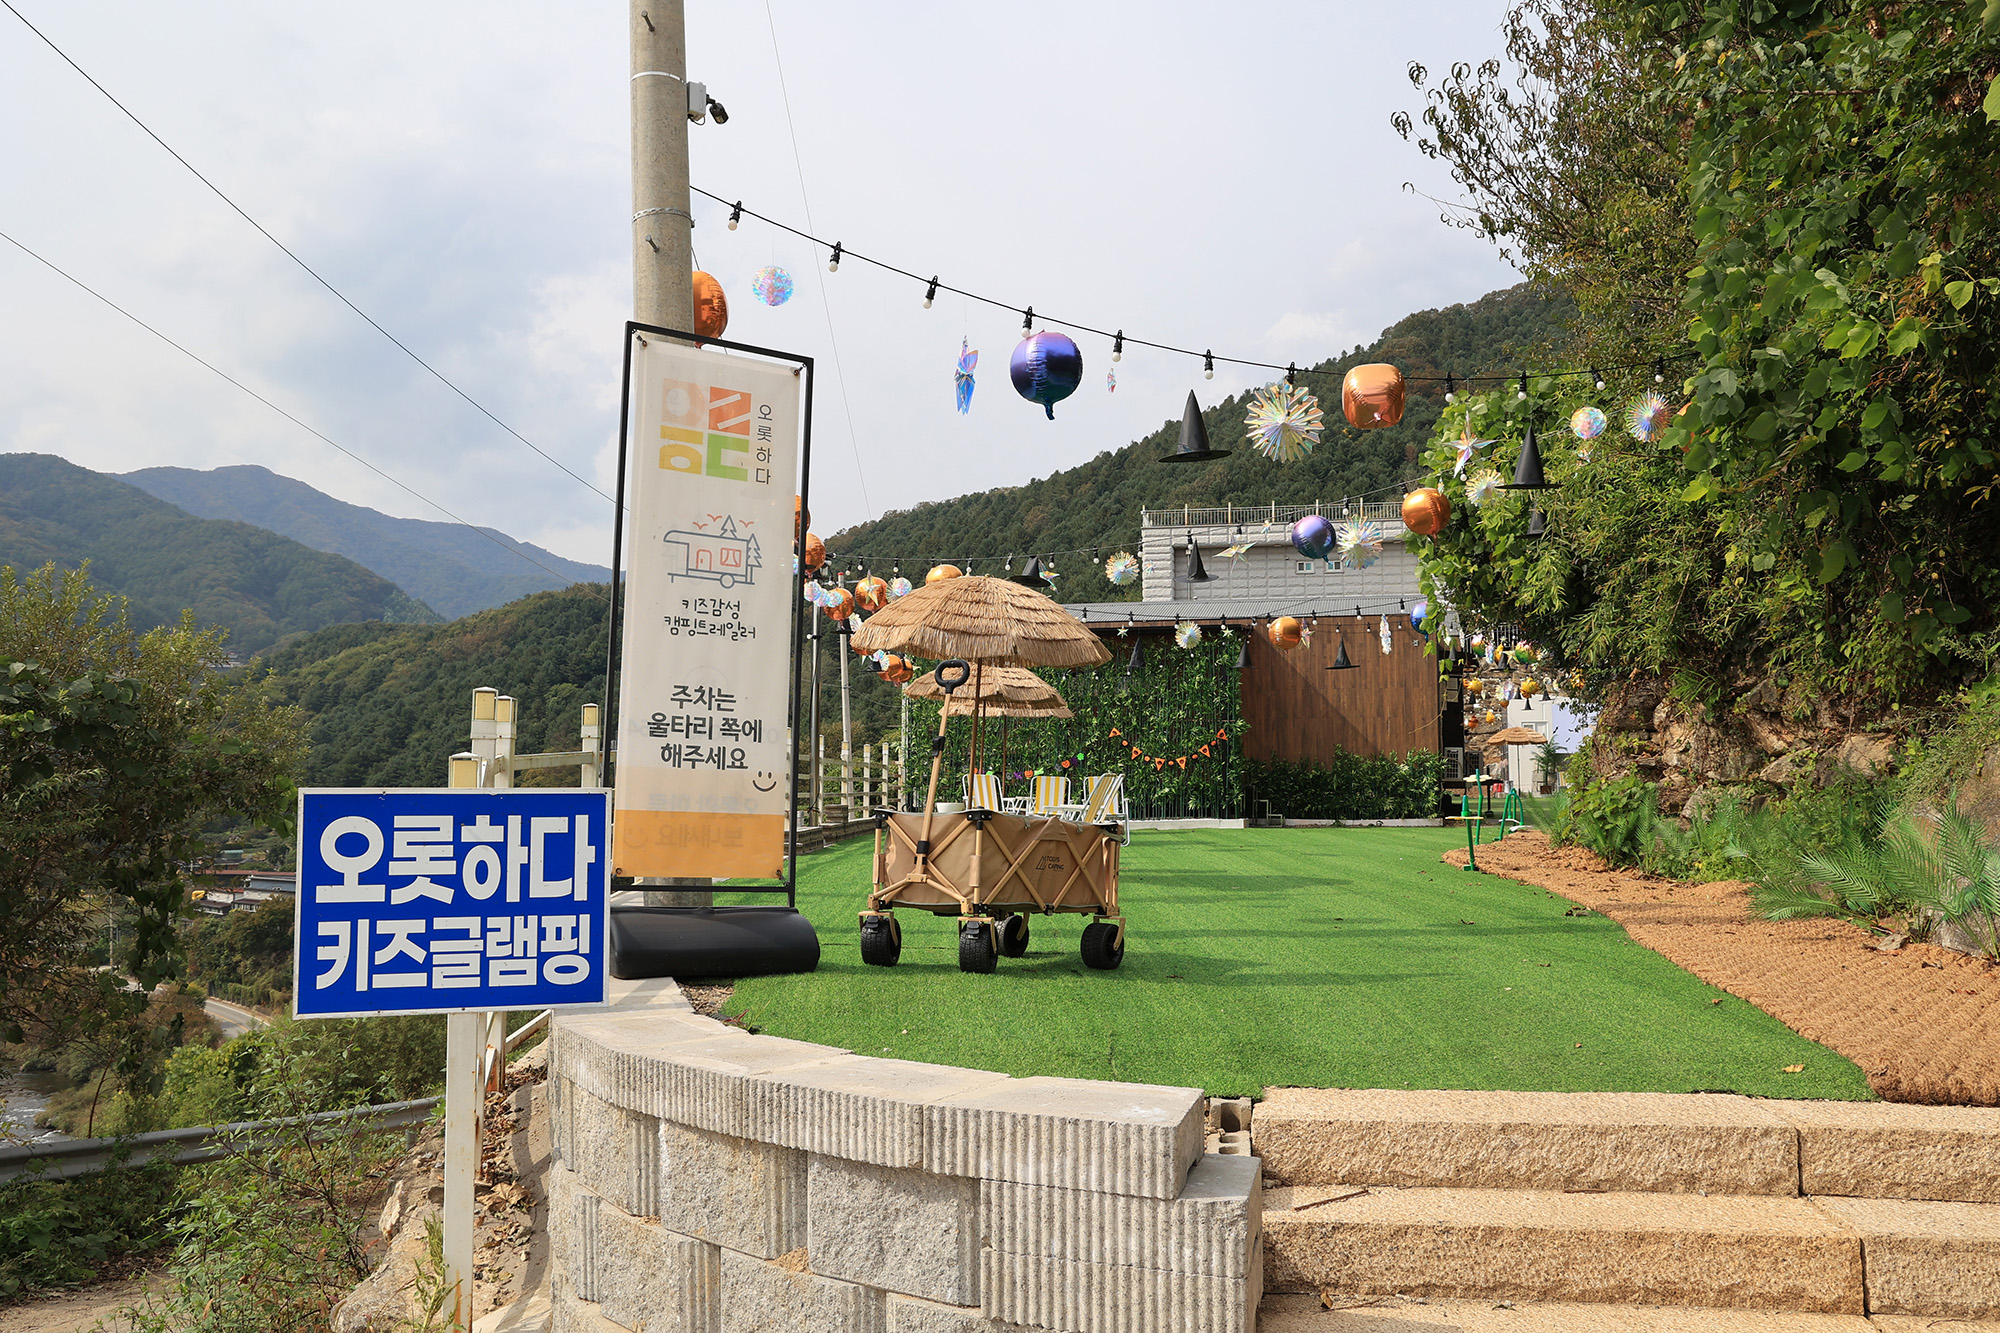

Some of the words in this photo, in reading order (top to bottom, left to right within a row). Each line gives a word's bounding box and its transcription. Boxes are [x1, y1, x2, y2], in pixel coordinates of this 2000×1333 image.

[755, 404, 773, 485] 오롯하다
[682, 598, 741, 620] 키즈감성
[664, 616, 756, 641] 캠핑트레일러
[670, 685, 737, 712] 주차는
[647, 712, 713, 740] 울타리
[719, 717, 763, 743] 쪽에
[660, 743, 748, 770] 해주세요
[315, 814, 596, 905] 오롯하다
[316, 914, 591, 992] 키즈글램핑
